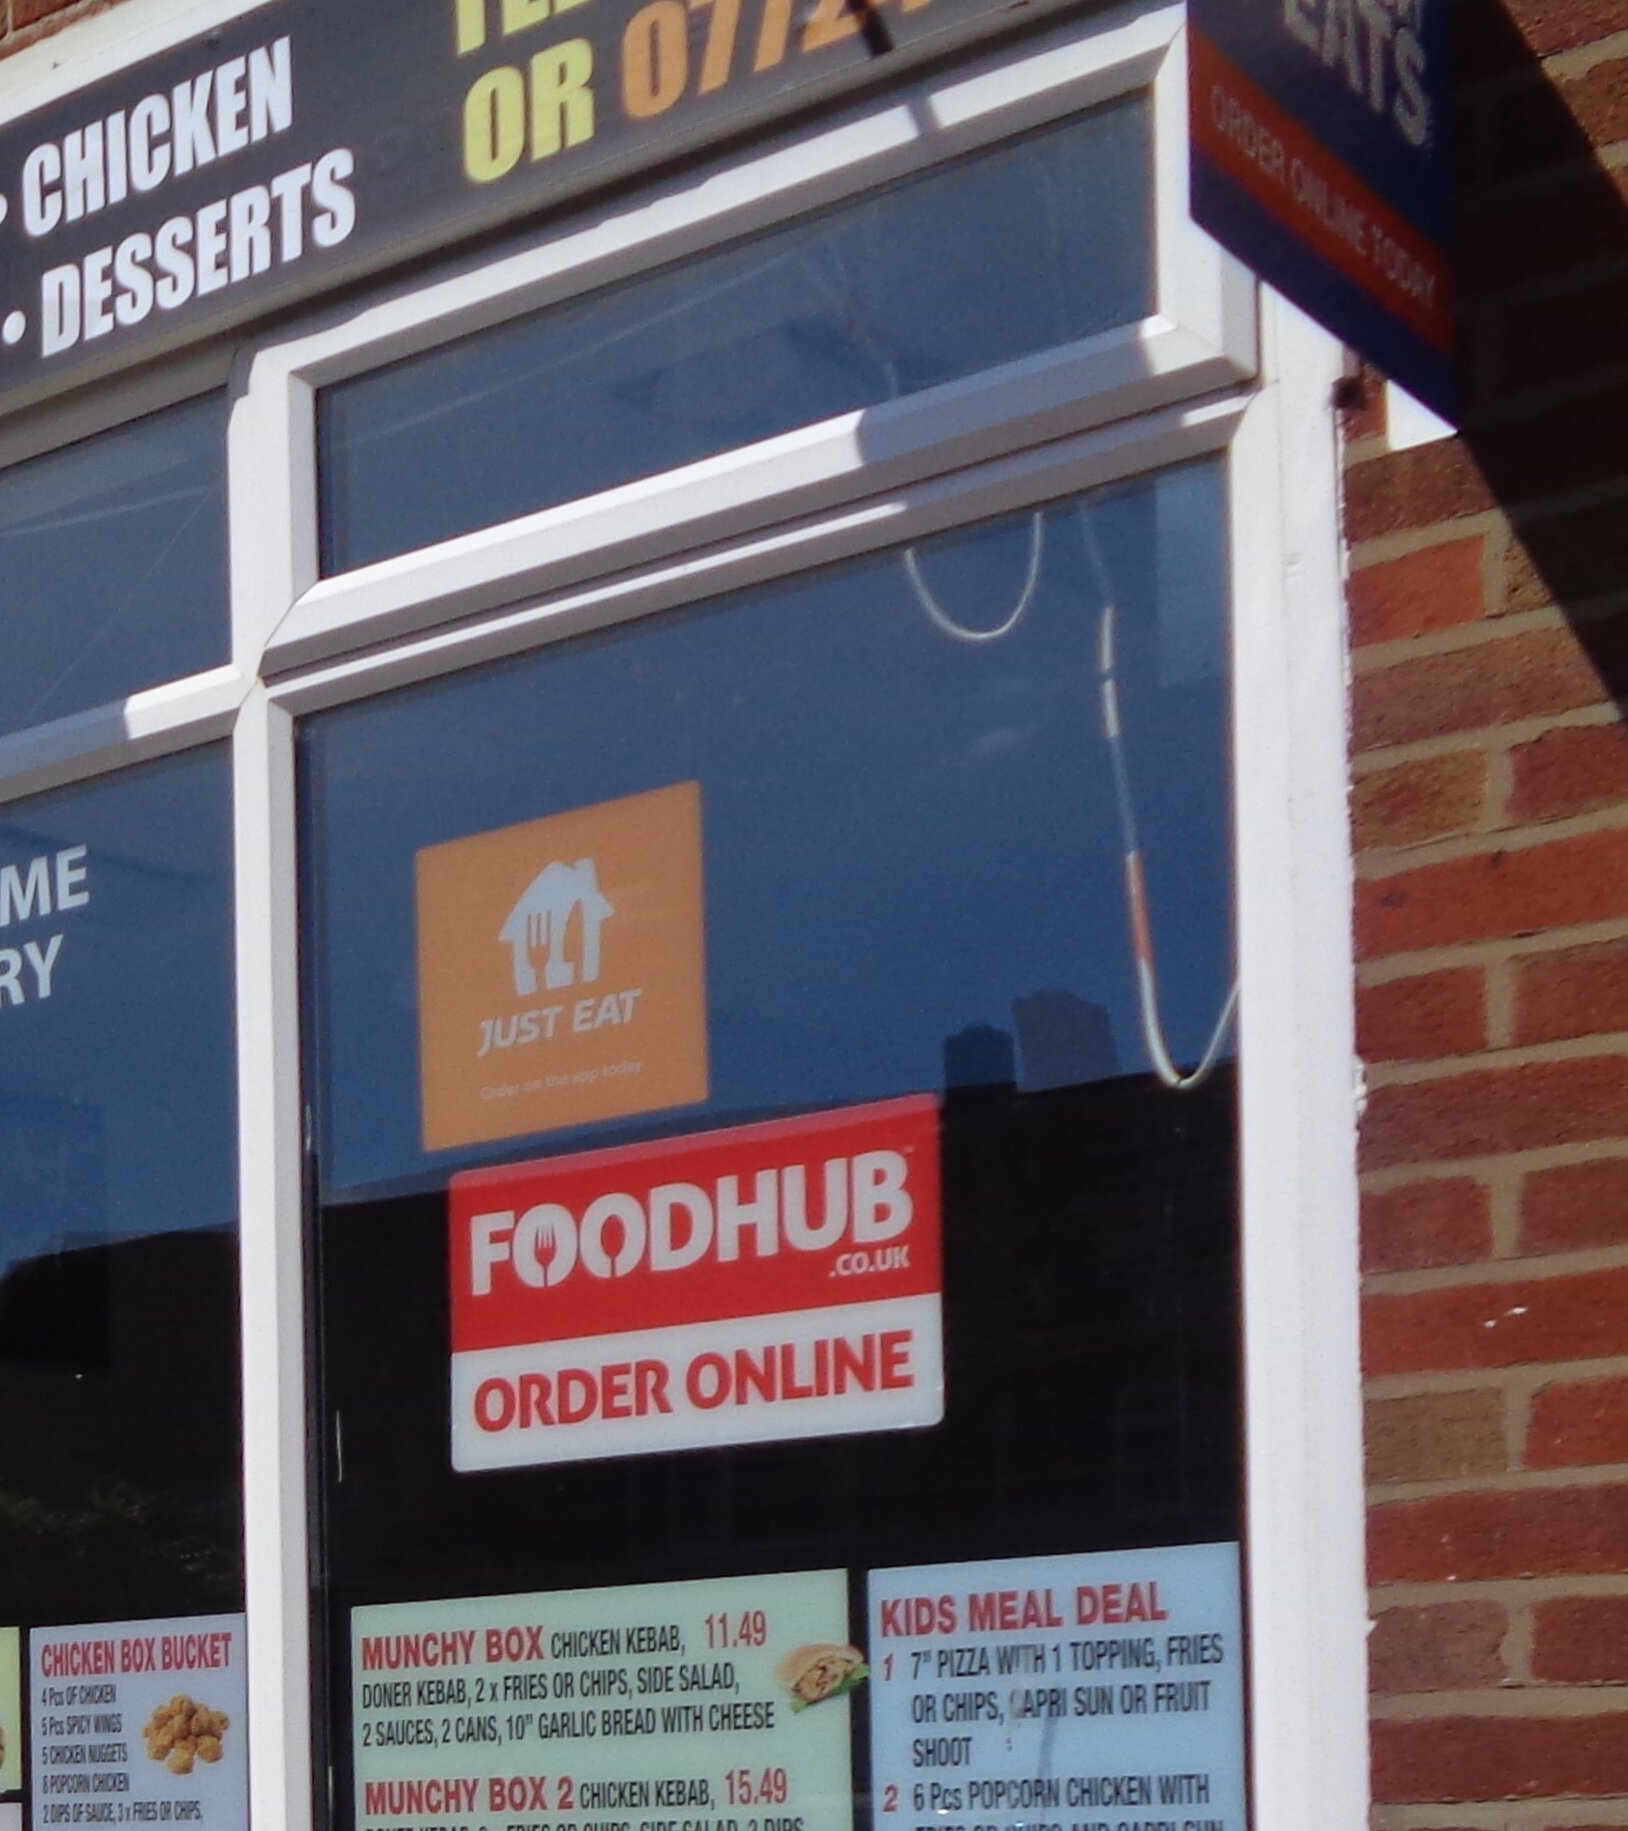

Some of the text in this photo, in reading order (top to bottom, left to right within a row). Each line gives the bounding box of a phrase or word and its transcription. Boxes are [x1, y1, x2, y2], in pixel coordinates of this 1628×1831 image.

[463, 37, 596, 185] OR
[620, 0, 934, 119] 077
[22, 34, 294, 240] CHICKEN
[39, 146, 358, 362] DESSERTS
[476, 987, 643, 1058] JUST EAT
[470, 1150, 914, 1297] FOODHUB
[827, 1245, 910, 1279] .CO.UK
[473, 1329, 915, 1434] ORDER ONLINE
[361, 1609, 767, 1670] MUNCHY BOX CHICKEN KEBAB, 11.49
[880, 1581, 1168, 1638] KIDS MEAL DEAL
[41, 1632, 233, 1678] CHICKEN BOX BUCKET
[365, 1767, 787, 1815] MUNCHY BOX 2 CHICKEN KEBAB, 15.49
